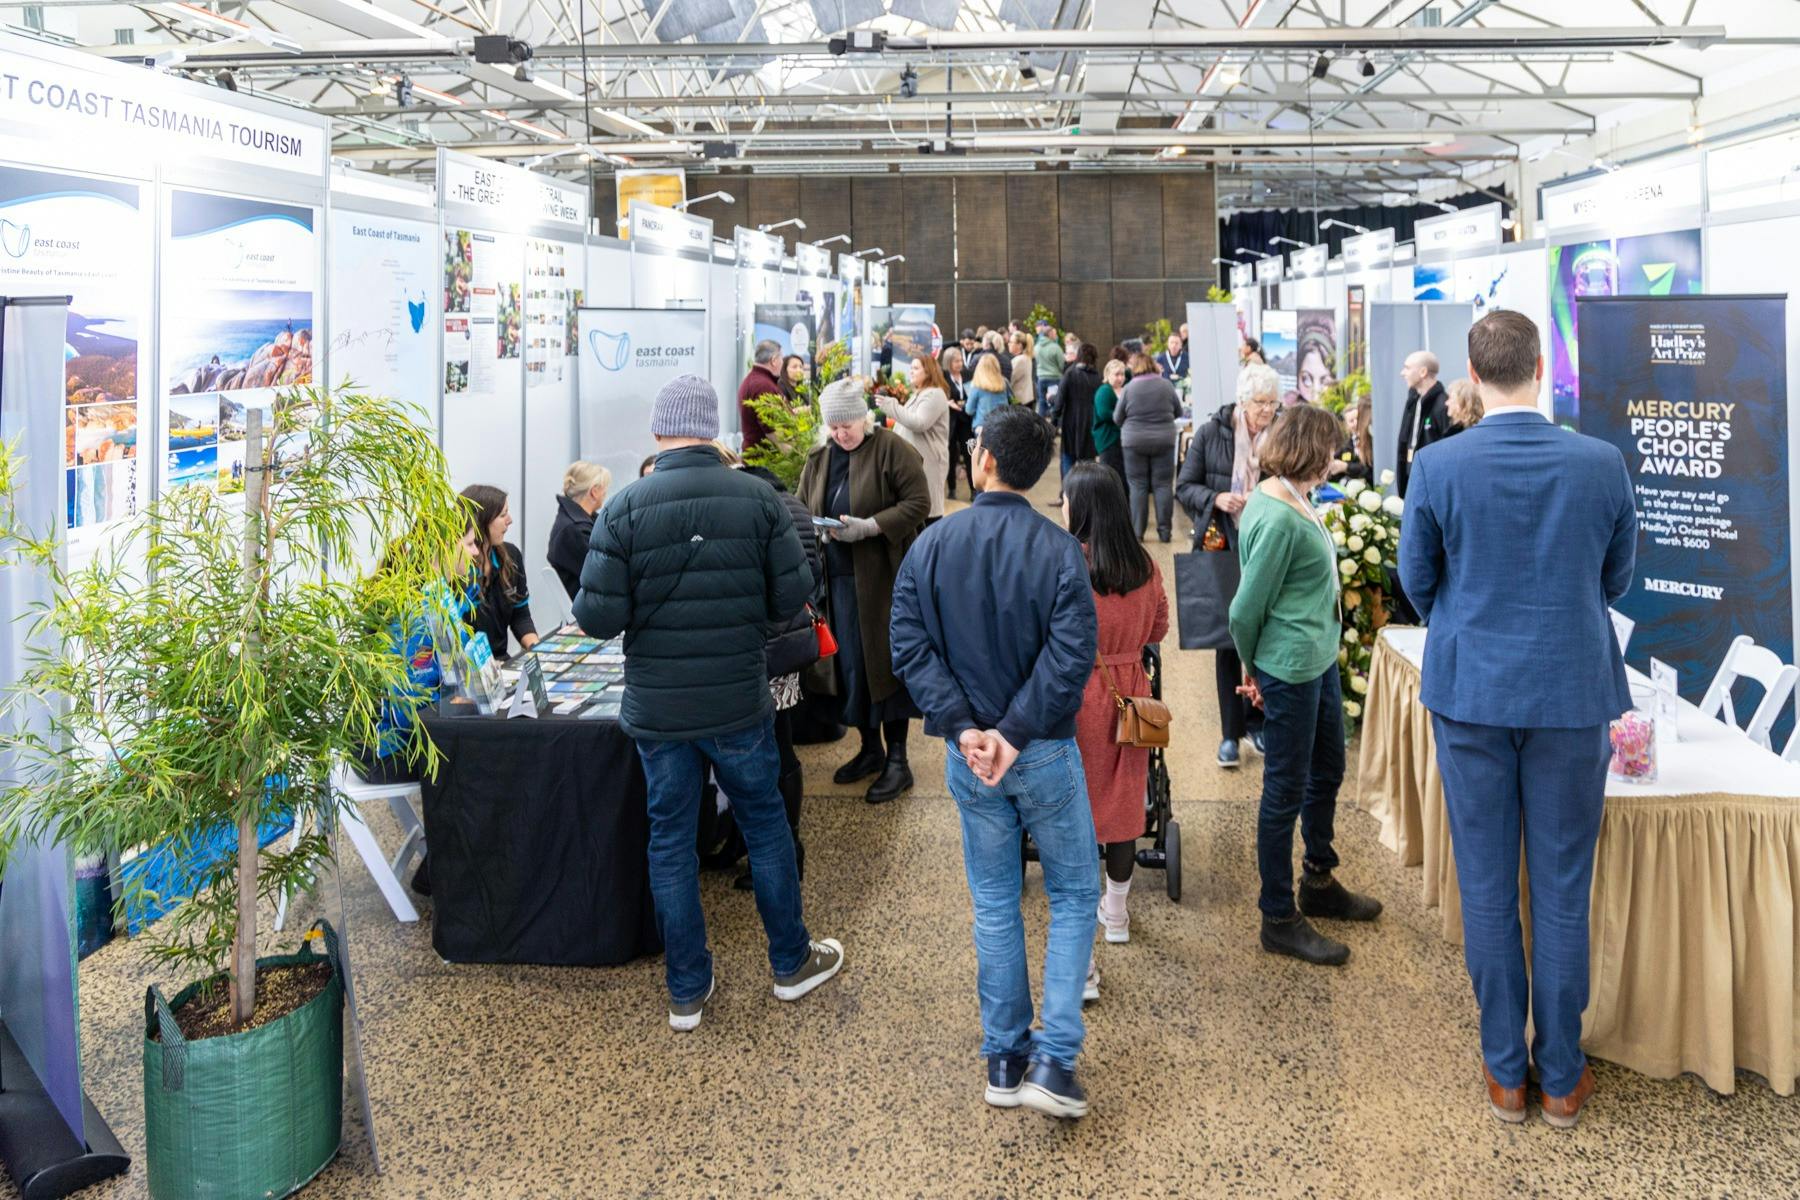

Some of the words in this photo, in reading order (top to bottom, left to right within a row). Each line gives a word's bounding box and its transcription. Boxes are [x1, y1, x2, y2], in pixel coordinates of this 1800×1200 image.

[28, 80, 114, 119] COAST
[120, 99, 225, 142] TASMANIA
[228, 123, 302, 158] TOURISM
[474, 170, 497, 187] EAST
[458, 184, 475, 202] THE
[559, 205, 578, 221] WEEK
[352, 226, 367, 236] East
[368, 227, 385, 239] Coast
[386, 229, 393, 240] of
[393, 230, 421, 243] Tasmania
[34, 237, 54, 248] east
[56, 239, 80, 250] coast
[1650, 334, 1706, 349] Hadley's
[635, 346, 663, 358] east
[665, 344, 695, 357] coast
[1651, 347, 1673, 359] Art
[1674, 347, 1706, 360] Prize
[635, 356, 679, 368] tasmania
[1626, 399, 1736, 421] MERCURY
[1630, 418, 1732, 441] PEOPLE'S
[1636, 437, 1725, 460] CHOICE
[1640, 457, 1723, 479] AWARD
[1635, 484, 1659, 496] Have
[1659, 488, 1681, 499] your
[1682, 490, 1697, 502] say
[1698, 490, 1716, 501] and
[1717, 493, 1730, 505] go
[1643, 497, 1652, 507] in
[1653, 498, 1669, 508] the
[1670, 500, 1692, 511] draw
[1693, 503, 1704, 512] to
[1704, 504, 1722, 514] win
[1646, 509, 1693, 524] indulgence
[1694, 515, 1732, 530] package
[1639, 521, 1677, 536] Hadley's
[1678, 524, 1709, 538] Orient
[1711, 527, 1738, 540] Hotel
[1655, 536, 1681, 547] worth
[1682, 536, 1711, 550] $600
[1643, 577, 1725, 601] MERCURY
